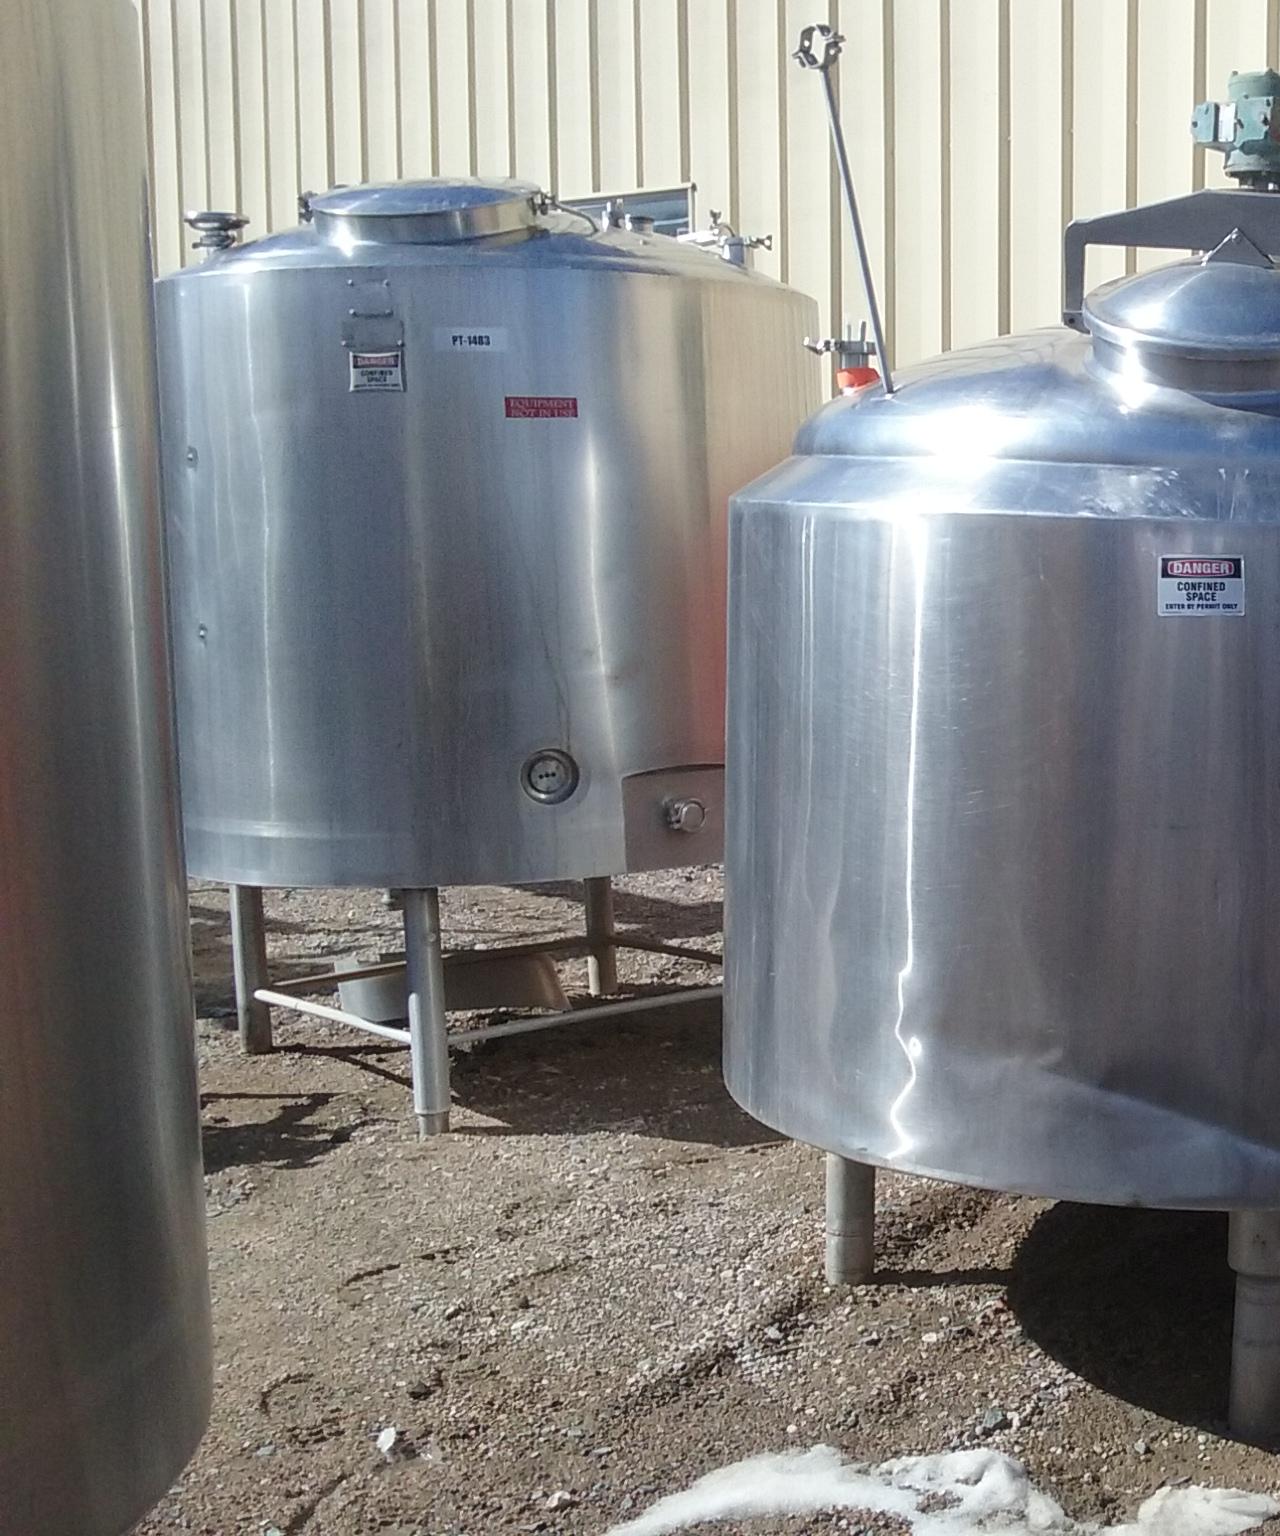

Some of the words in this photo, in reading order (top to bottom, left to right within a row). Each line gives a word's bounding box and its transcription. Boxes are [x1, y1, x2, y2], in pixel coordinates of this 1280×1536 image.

[510, 399, 574, 409] EQUIPMENT
[1173, 562, 1229, 574] DANGER
[1177, 582, 1226, 591] CONFINED
[1186, 592, 1217, 601] SPACE
